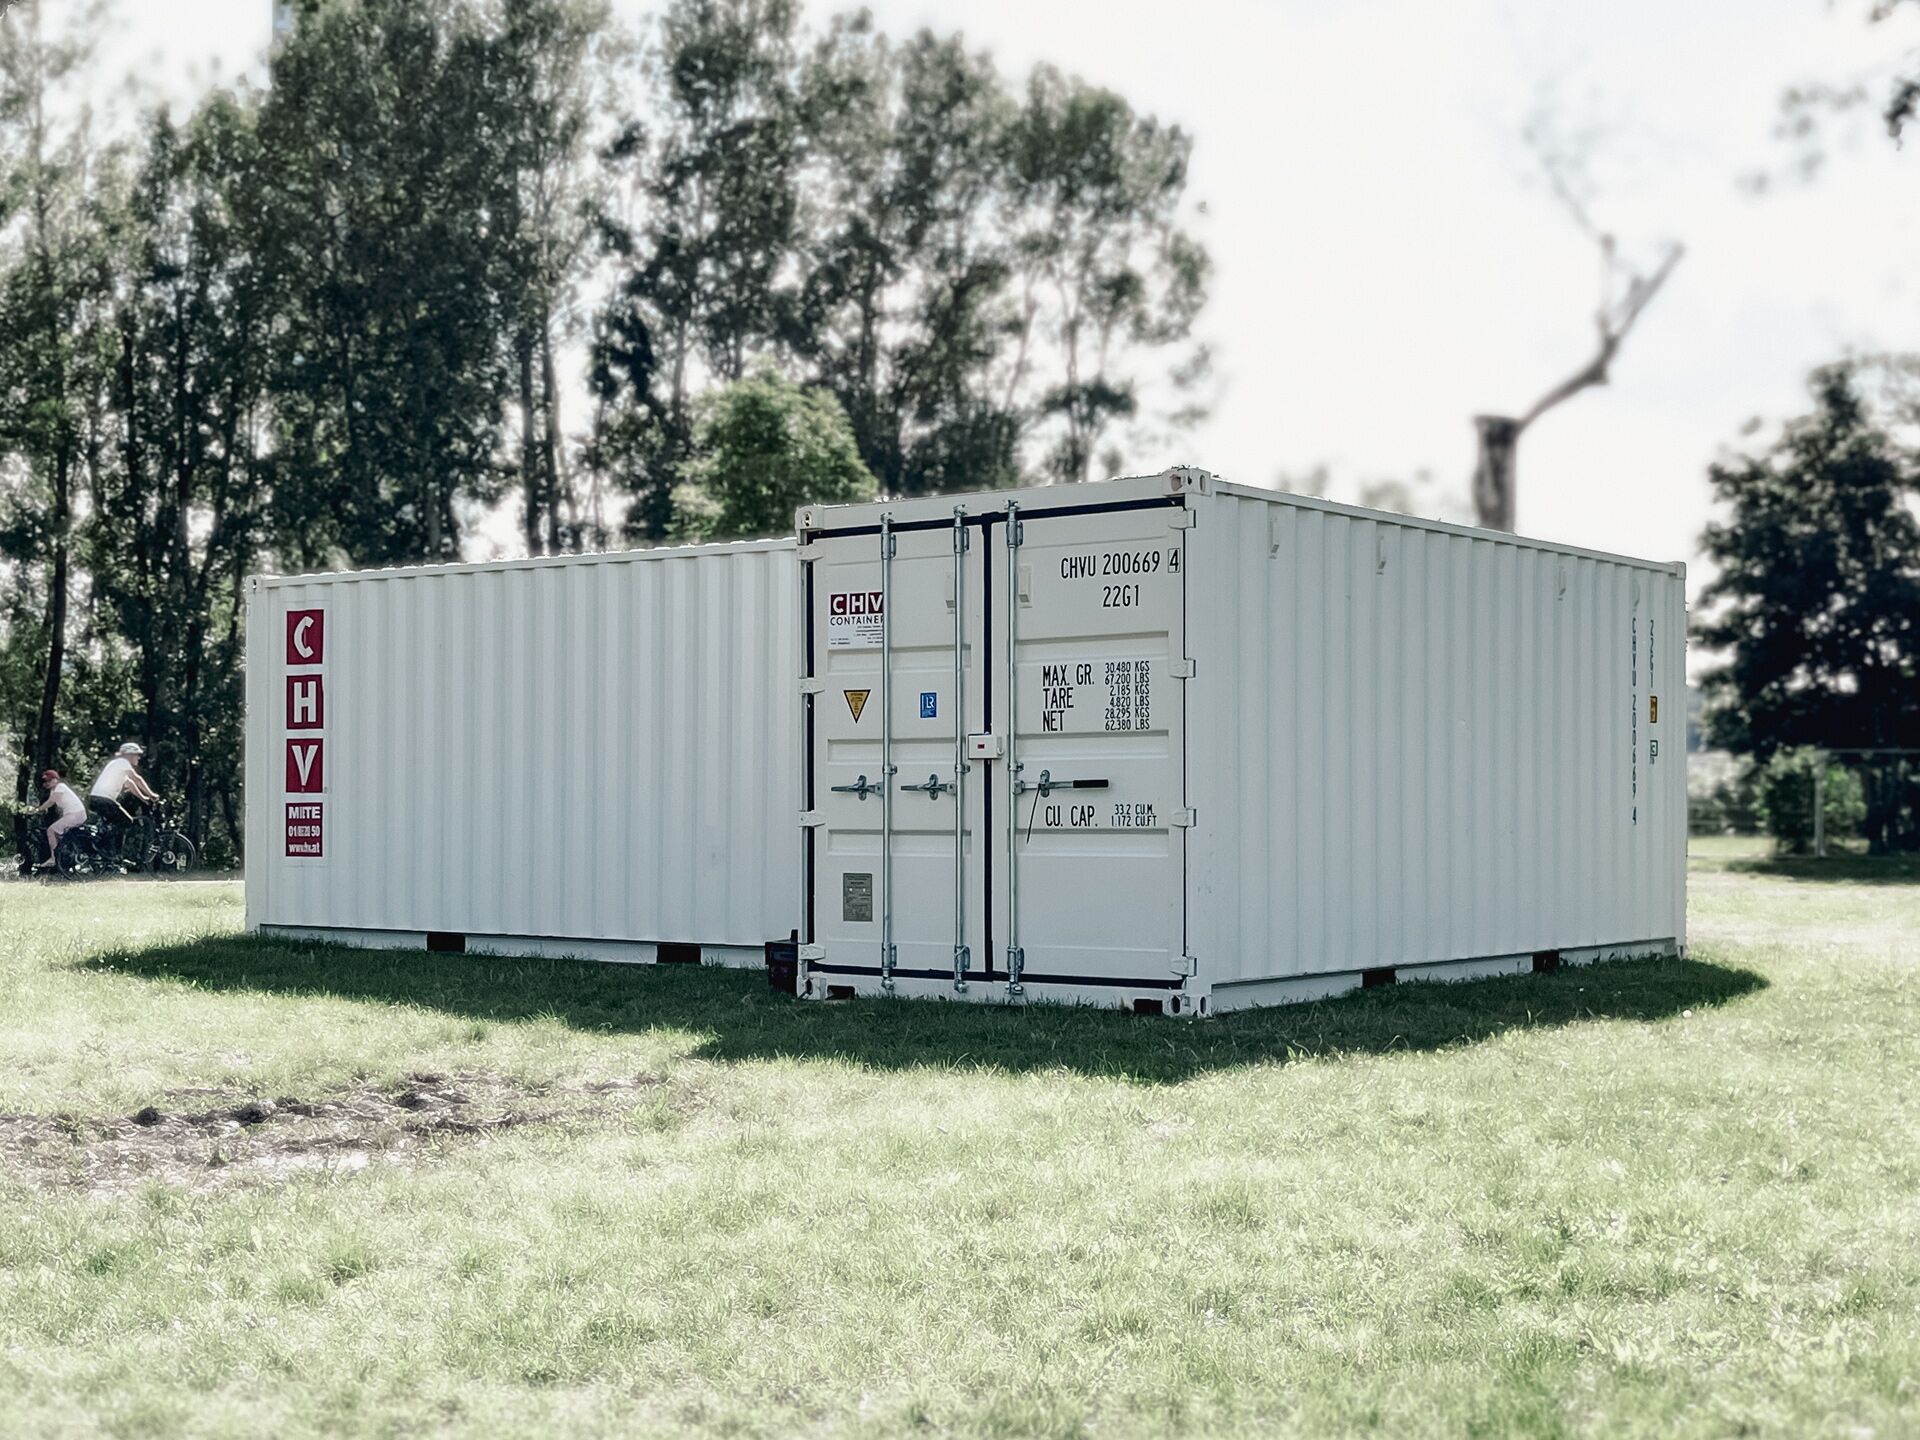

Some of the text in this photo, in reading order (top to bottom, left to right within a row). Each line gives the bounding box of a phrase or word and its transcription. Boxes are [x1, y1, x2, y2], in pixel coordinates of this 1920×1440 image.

[1061, 549, 1179, 579] CHVU 200669 4
[832, 594, 883, 614] CHV
[1103, 584, 1139, 607] 22G1
[1043, 664, 1095, 687] MAX. GR.
[1105, 661, 1149, 673] 30.480 KGS
[1105, 672, 1149, 685] 67.200 LBS
[1043, 687, 1074, 709] TARE
[1110, 684, 1149, 696] 2.185 KGS
[290, 614, 320, 788] CHV
[1110, 695, 1149, 707] 4.820 LBS
[1043, 710, 1065, 731] NET
[1105, 707, 1149, 719] 28.295 KGS
[1105, 719, 1150, 731] 62.380 LBS
[1045, 805, 1098, 827] CU. CAP.
